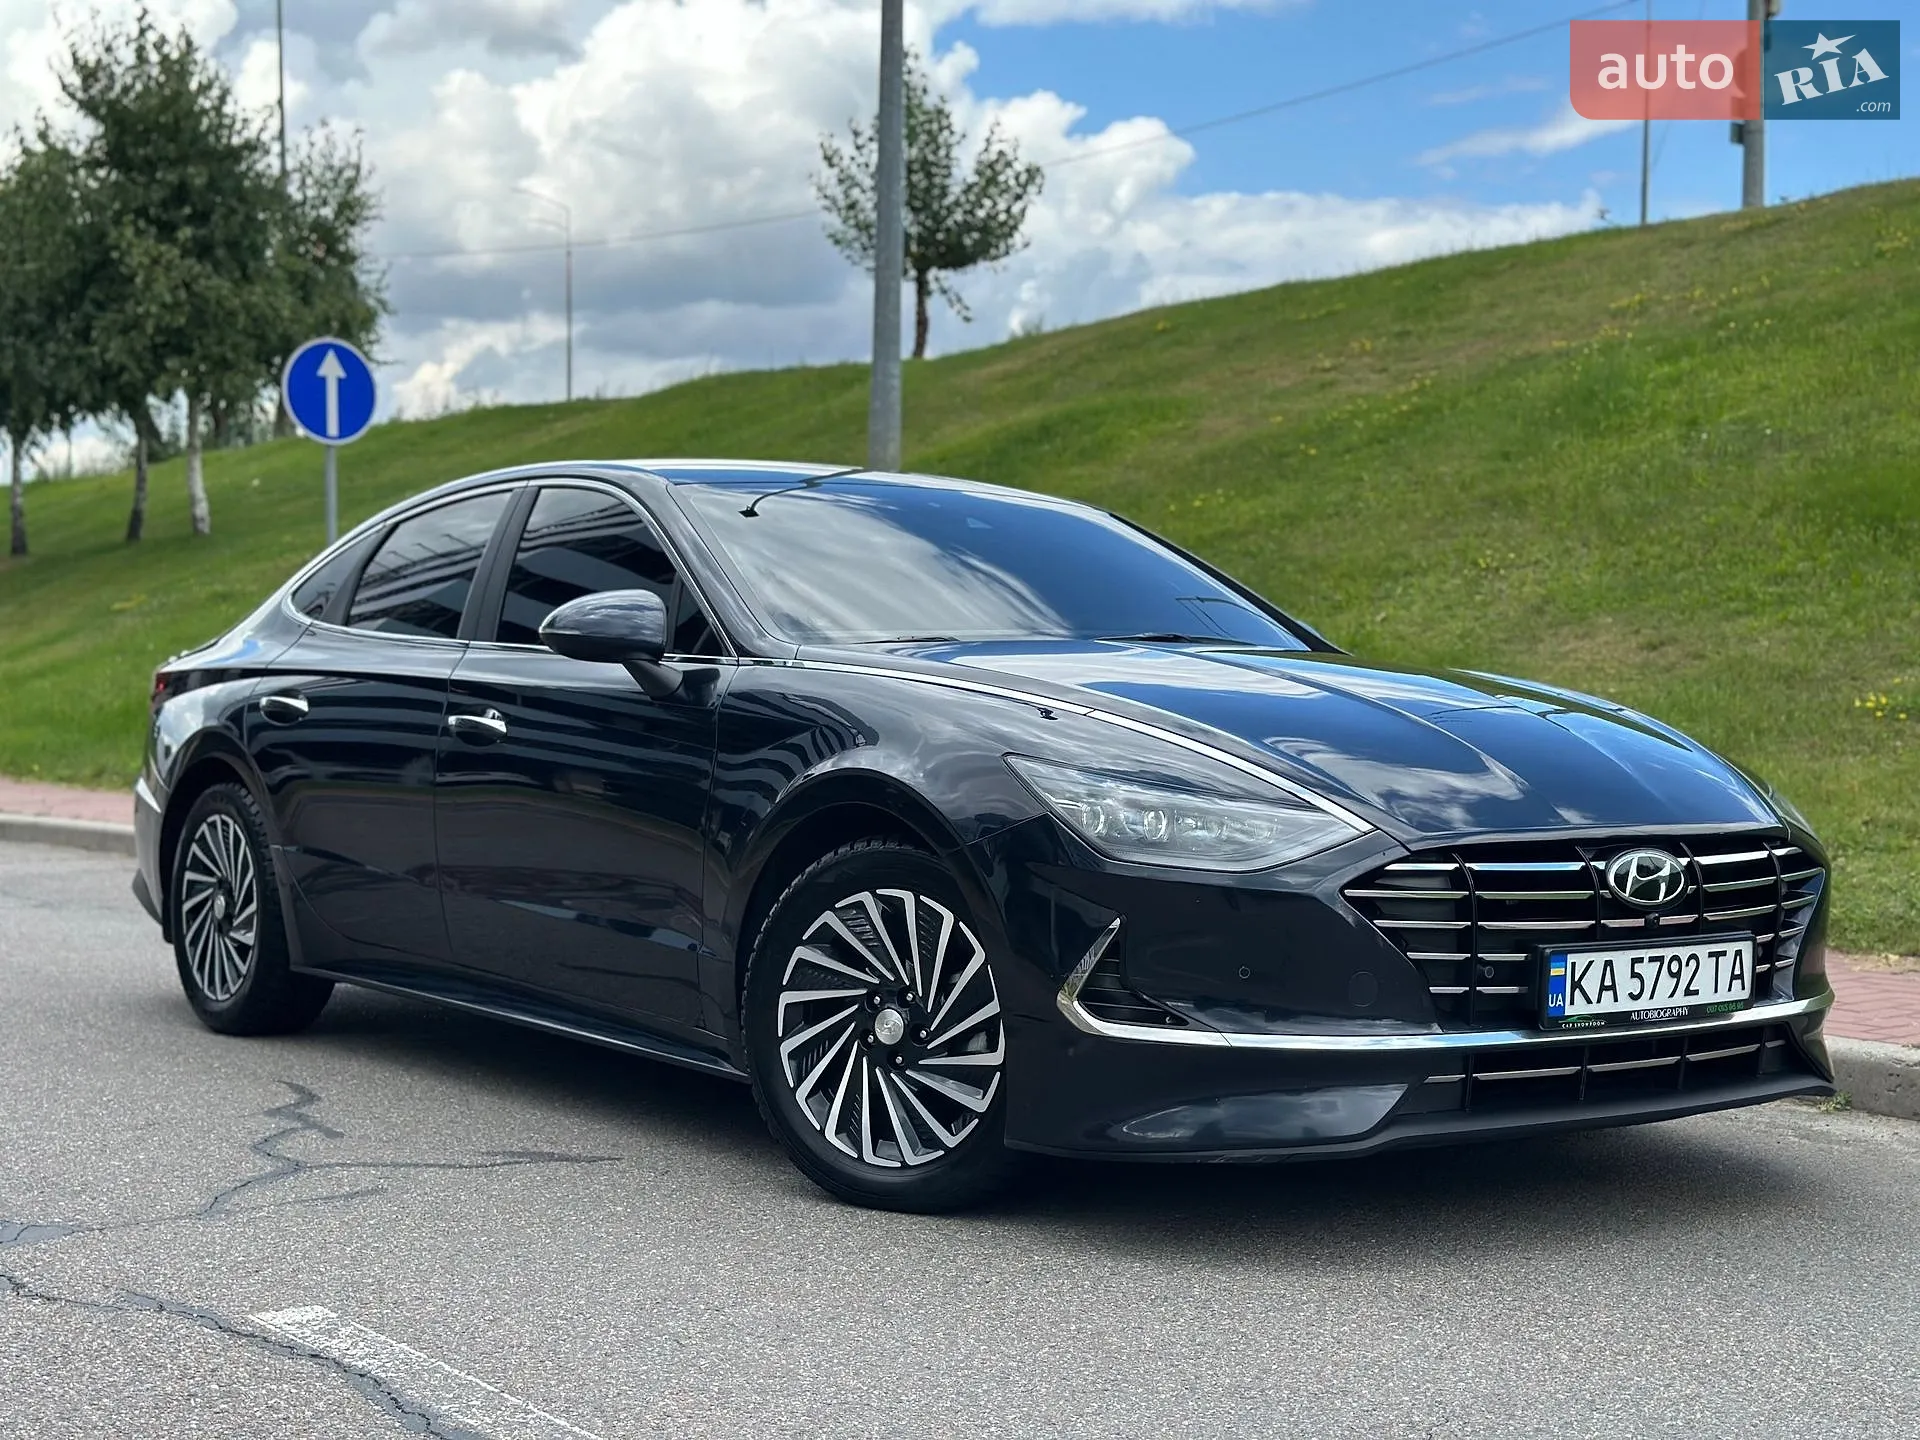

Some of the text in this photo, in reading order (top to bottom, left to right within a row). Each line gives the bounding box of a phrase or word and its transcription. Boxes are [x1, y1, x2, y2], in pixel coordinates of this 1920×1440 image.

[1569, 949, 1746, 1006] KA 5792 TA
[1548, 992, 1564, 1008] UA
[1630, 1006, 1690, 1021] AUTOBIOGRAPHY
